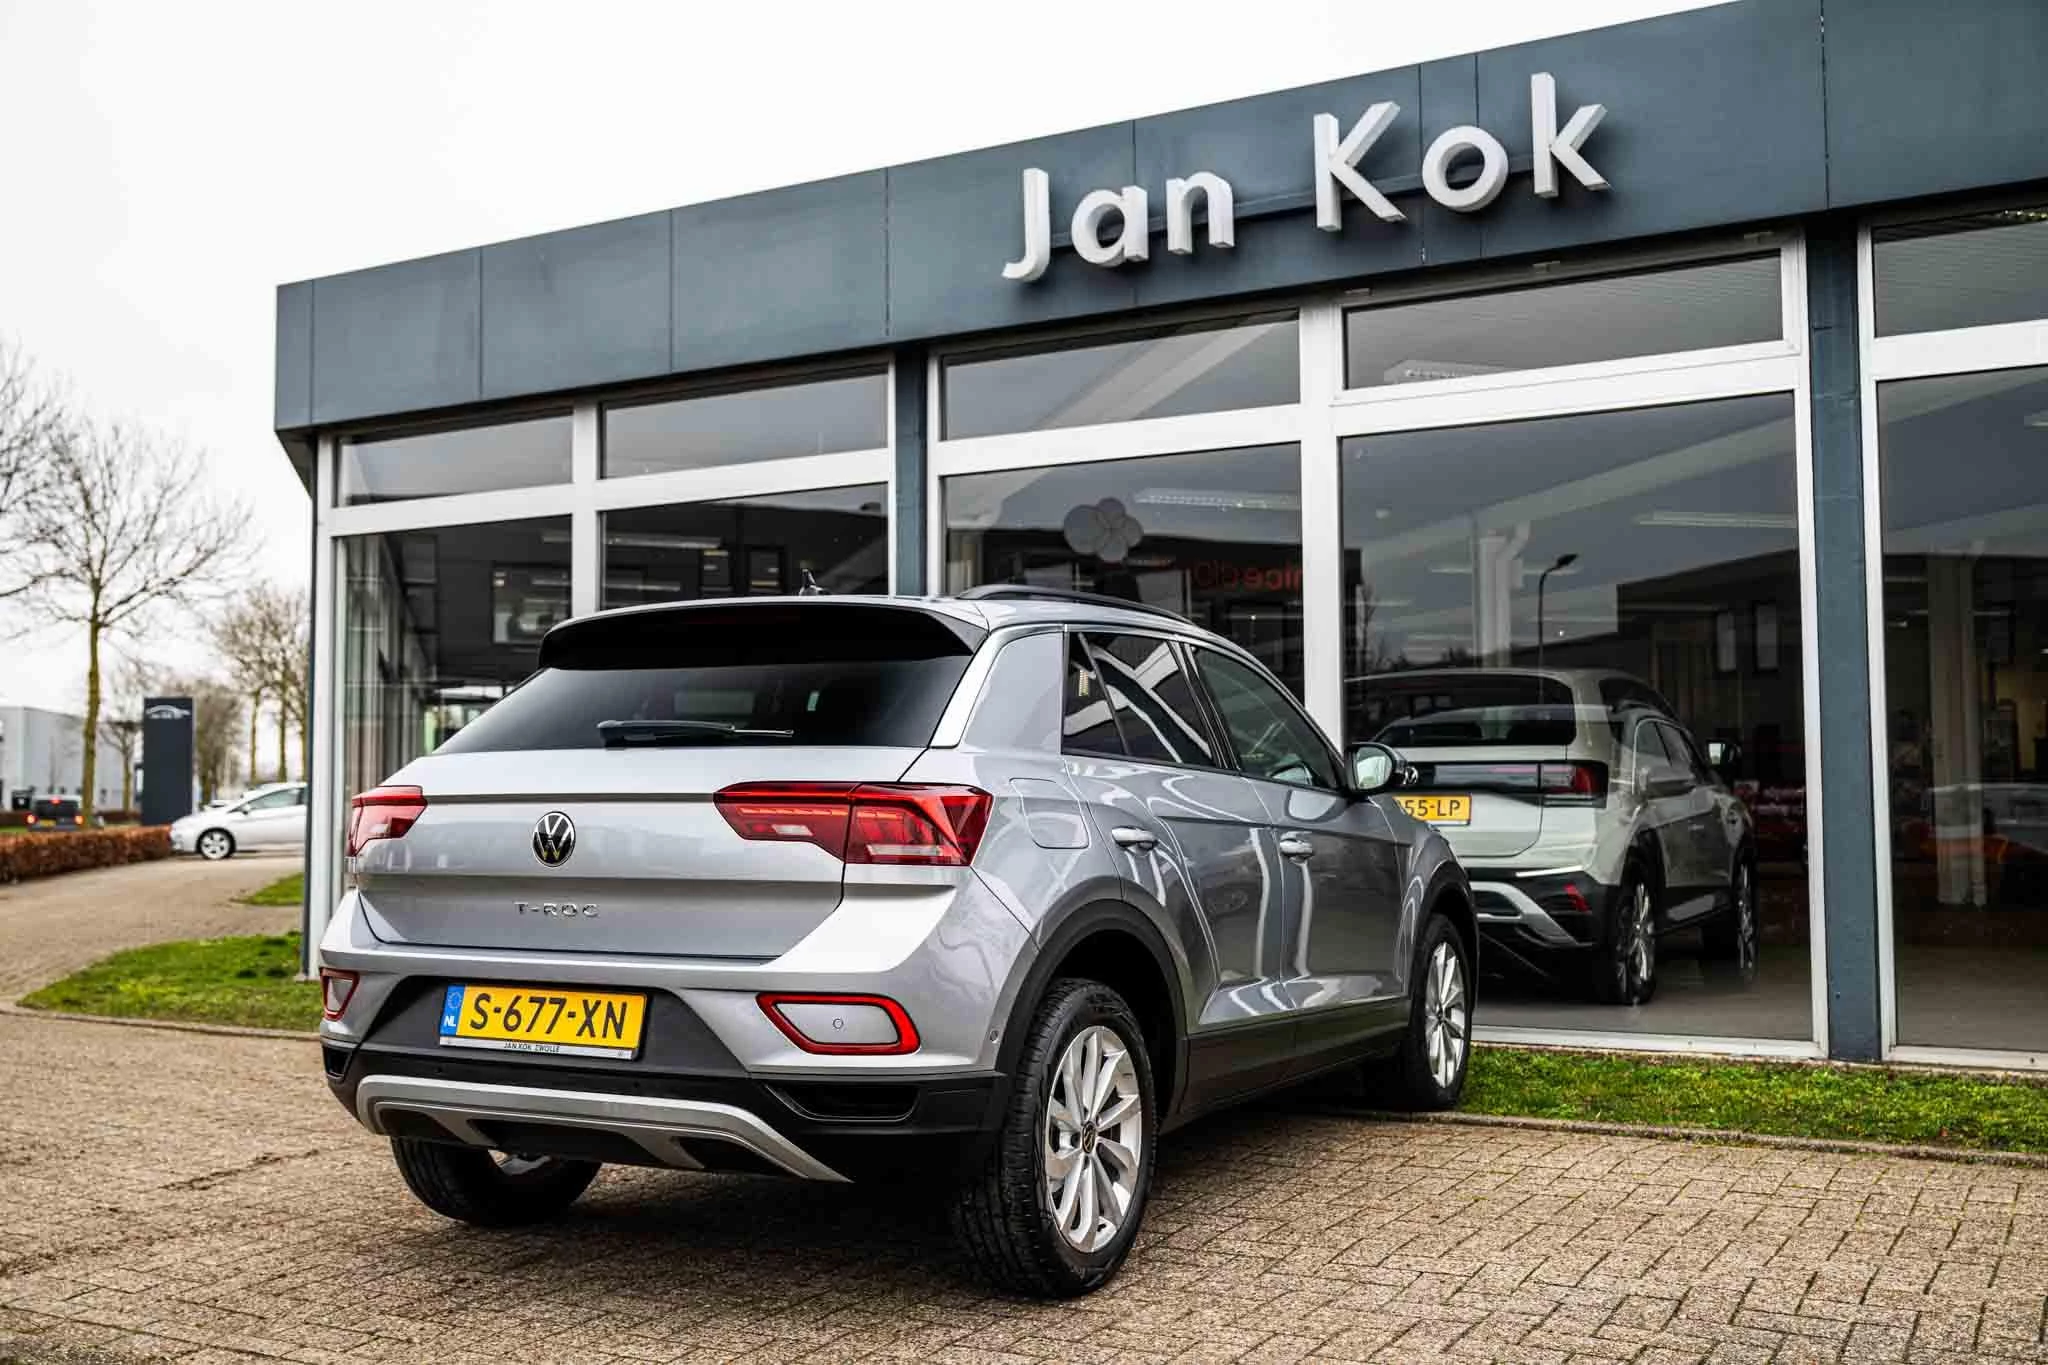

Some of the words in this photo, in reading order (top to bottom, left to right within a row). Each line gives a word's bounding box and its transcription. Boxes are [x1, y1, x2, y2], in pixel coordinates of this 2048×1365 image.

[1001, 167, 1235, 283] Jan
[1313, 72, 1613, 231] Kok
[1397, 799, 1461, 817] 55-LP
[513, 902, 599, 917] T-ROC
[444, 1016, 457, 1028] NL
[469, 992, 628, 1040] S-677-XN
[503, 1042, 517, 1050] JAN
[535, 1044, 561, 1053] ZWOLLE
